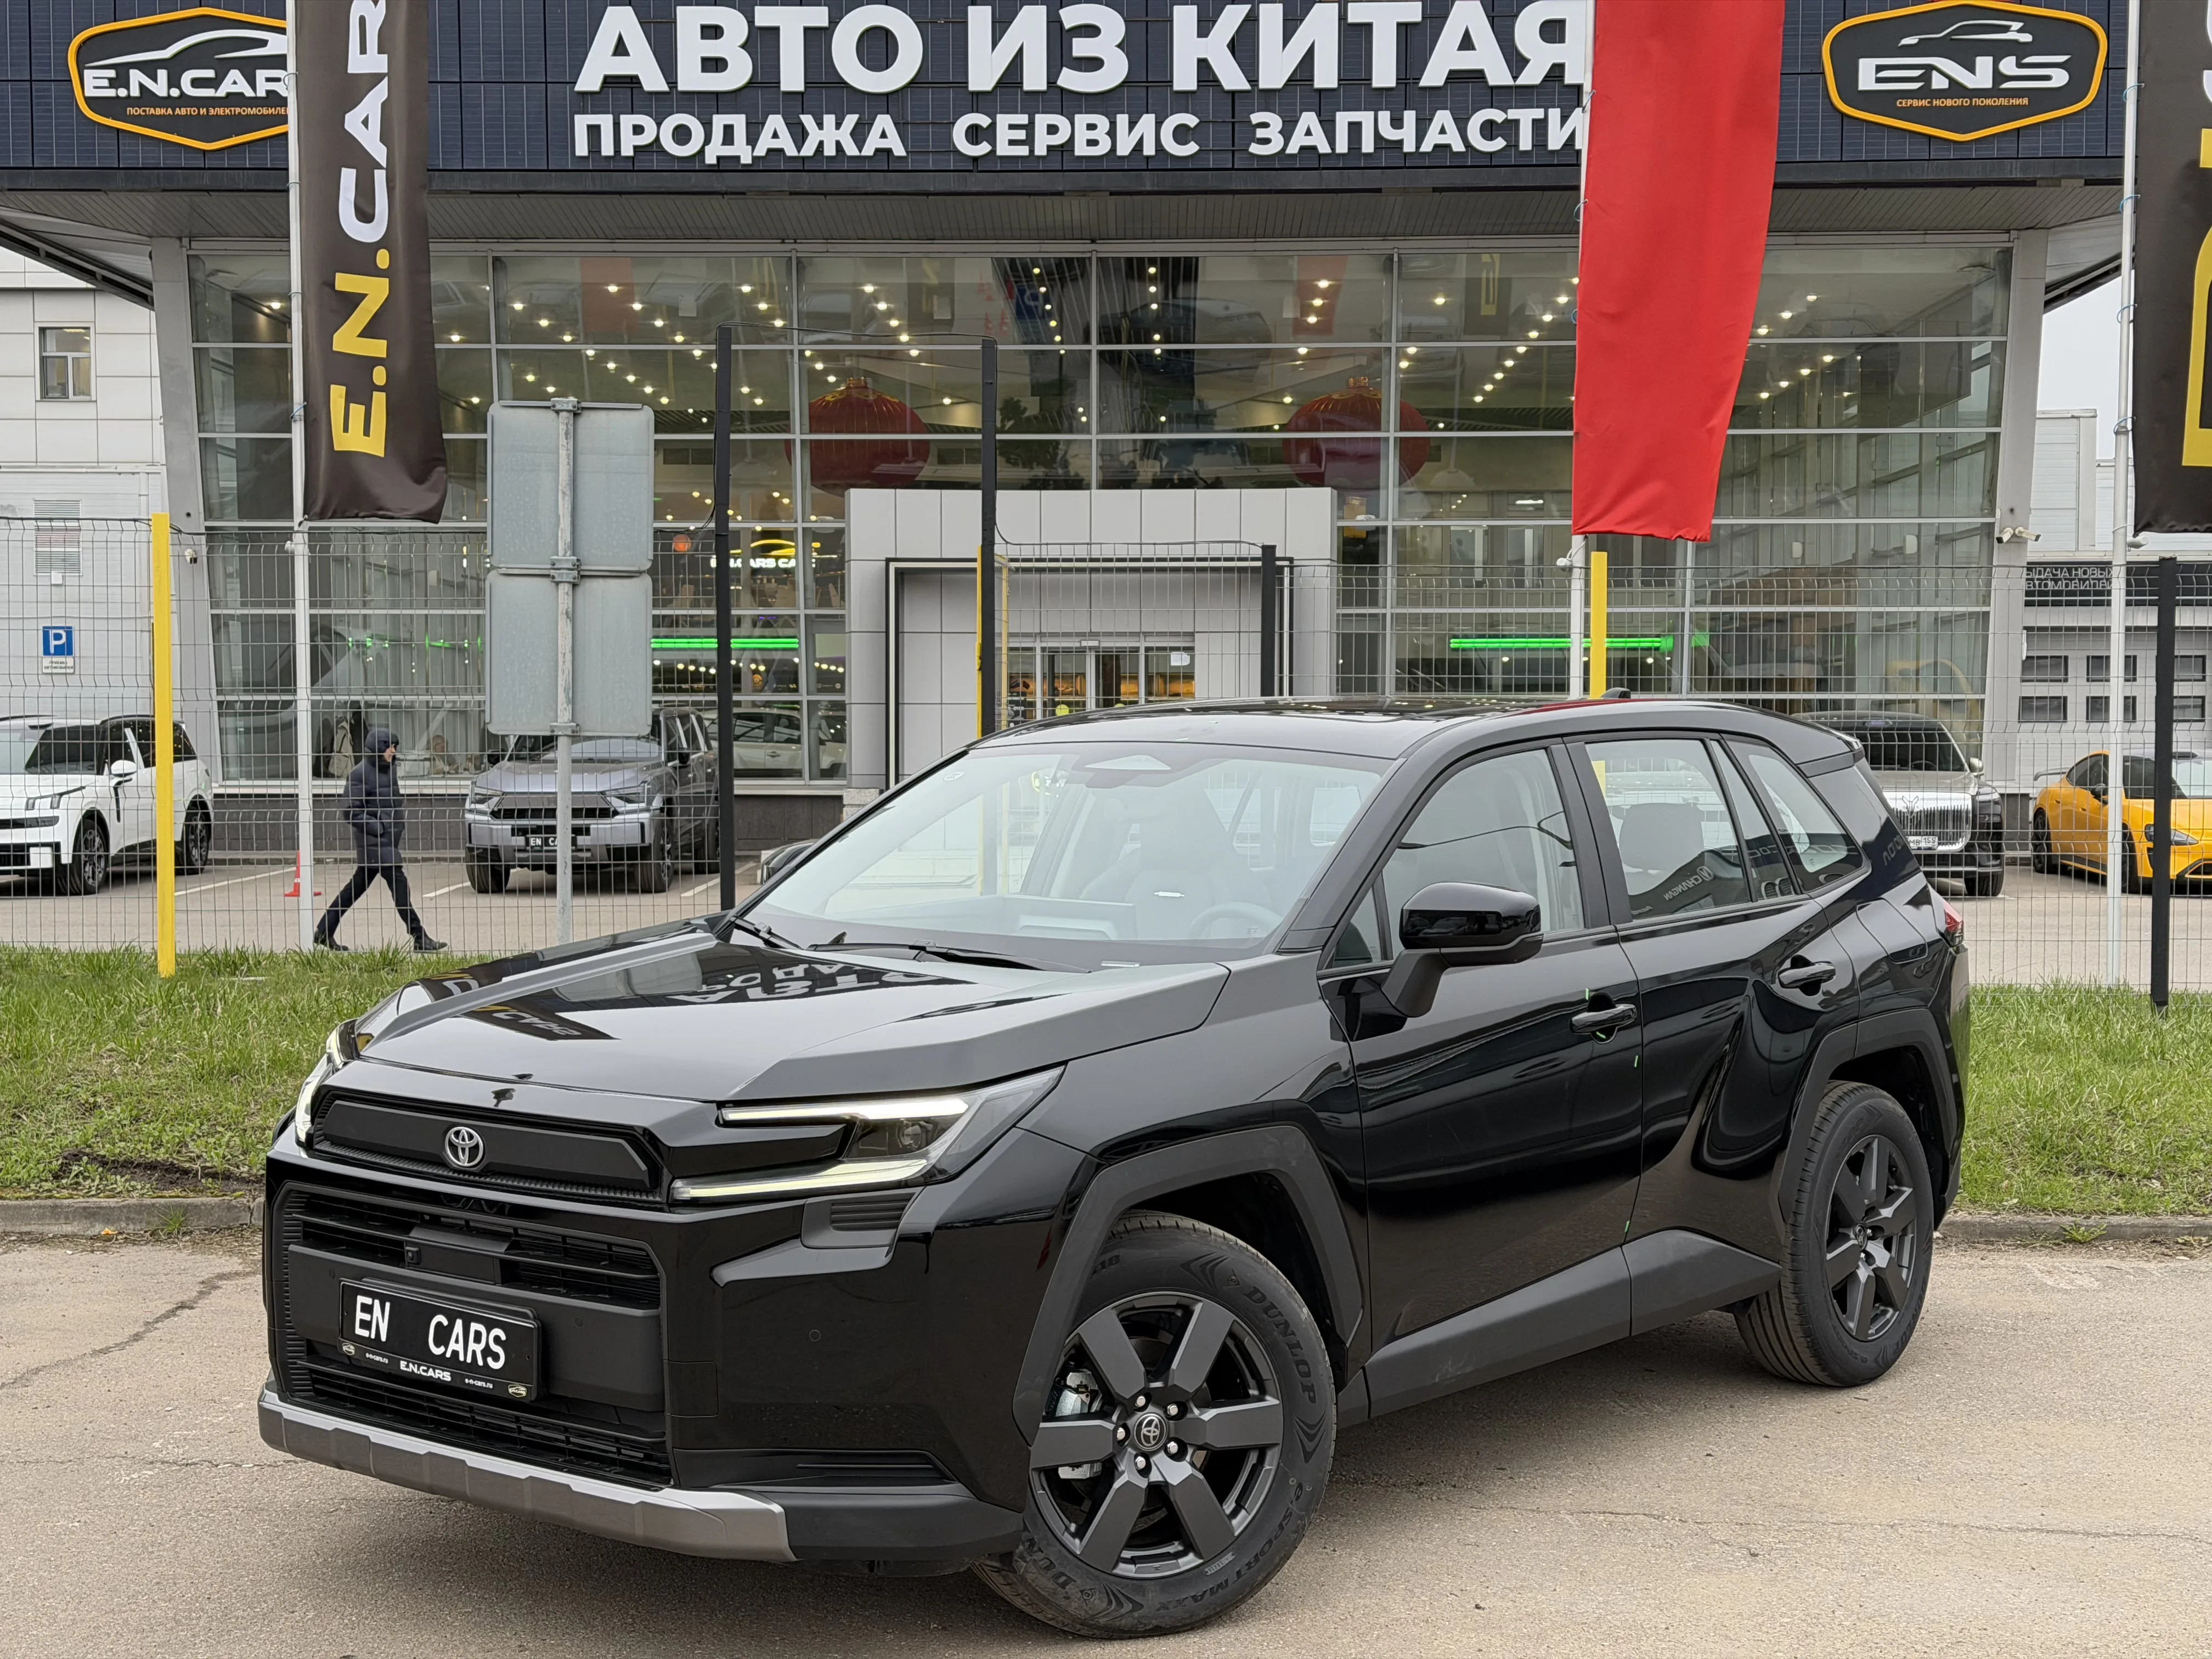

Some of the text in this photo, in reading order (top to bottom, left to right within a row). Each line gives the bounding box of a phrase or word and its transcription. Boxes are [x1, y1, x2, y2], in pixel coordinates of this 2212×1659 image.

[574, 0, 1584, 93] АВТО ИЗ КИТАЯ
[83, 69, 288, 98] E.N.CAR
[1858, 55, 2072, 91] ENS
[127, 106, 289, 116] ПОСТАВКА АВТО И ЭЛЕКТРОМОБИЛЕ
[1897, 97, 2029, 107] СЕРВИС НОВОГО ПОКОЛЕНИЯ
[574, 108, 1583, 165] ПРОДАЖА СЕРВИС ЗАПЧАСТИ
[2025, 567, 2069, 578] ЫДАЧА
[2026, 579, 2113, 590] ВТОМОБИЛЕЙ
[531, 837, 541, 846] EN
[355, 1295, 507, 1369] EN CARS
[1243, 1286, 1317, 1404] DUNLOP
[400, 1360, 452, 1382] E.N.CARS
[465, 1377, 493, 1389] e-n-cars.ru
